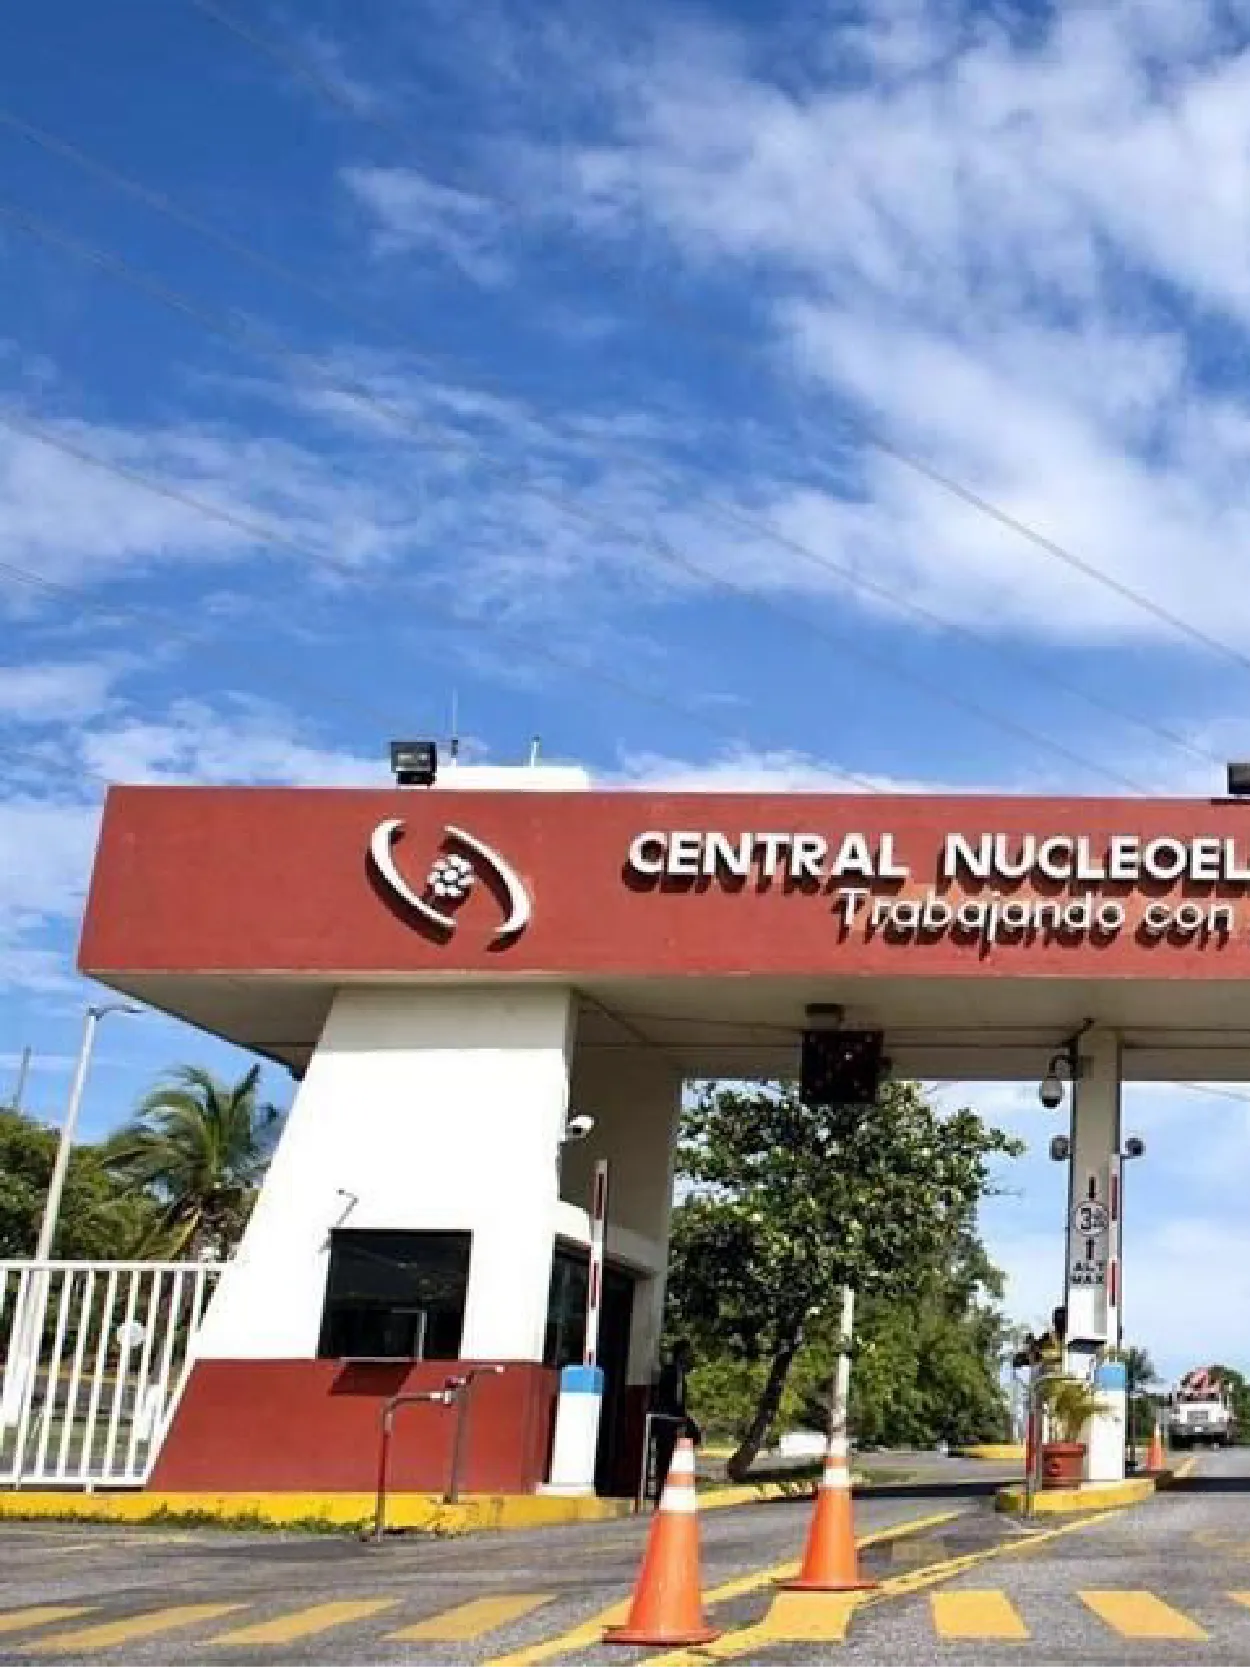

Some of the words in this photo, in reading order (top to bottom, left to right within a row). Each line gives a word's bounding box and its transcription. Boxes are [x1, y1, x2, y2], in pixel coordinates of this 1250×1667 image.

[628, 831, 910, 877] CENTRAL
[837, 888, 1127, 941] Trabajando
[1142, 898, 1236, 933] con
